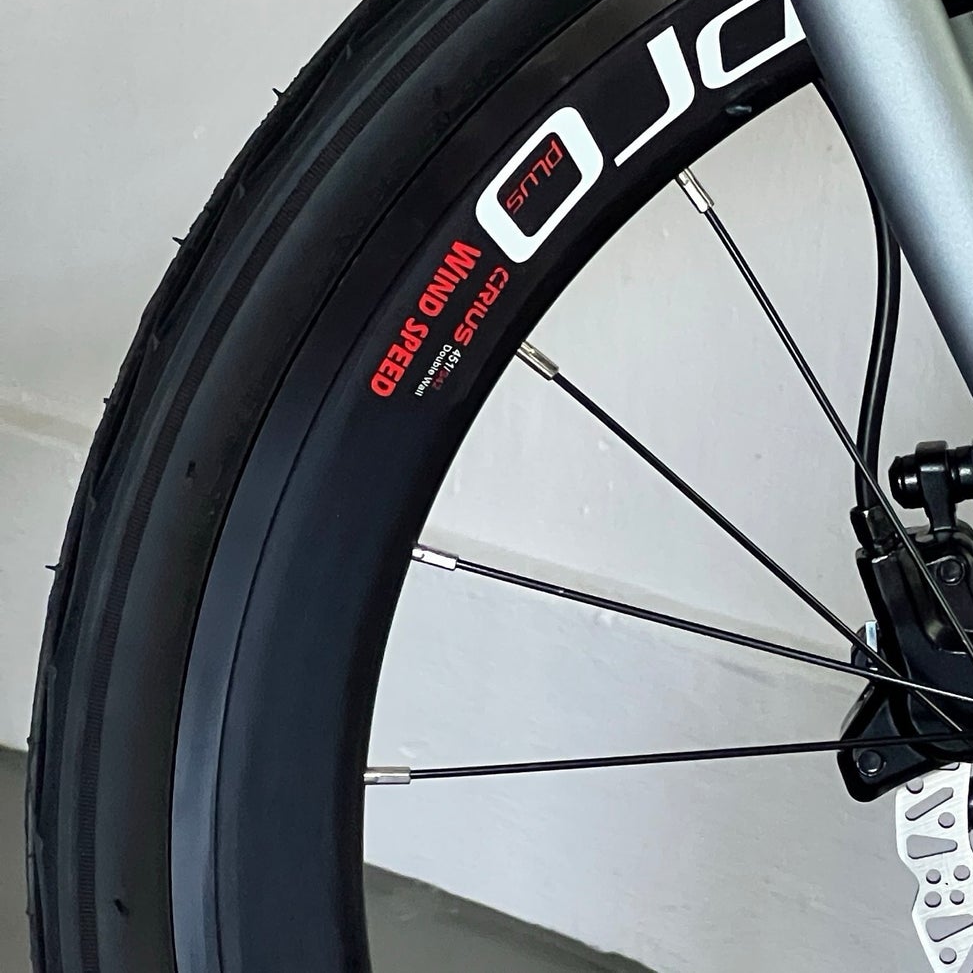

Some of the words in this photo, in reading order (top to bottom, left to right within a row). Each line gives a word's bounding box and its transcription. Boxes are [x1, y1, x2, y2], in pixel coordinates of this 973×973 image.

[418, 240, 482, 317] WIND
[454, 267, 510, 346] CRIUS
[370, 317, 430, 397] SPEED
[414, 376, 433, 397] Wall
[427, 344, 453, 376] Double
